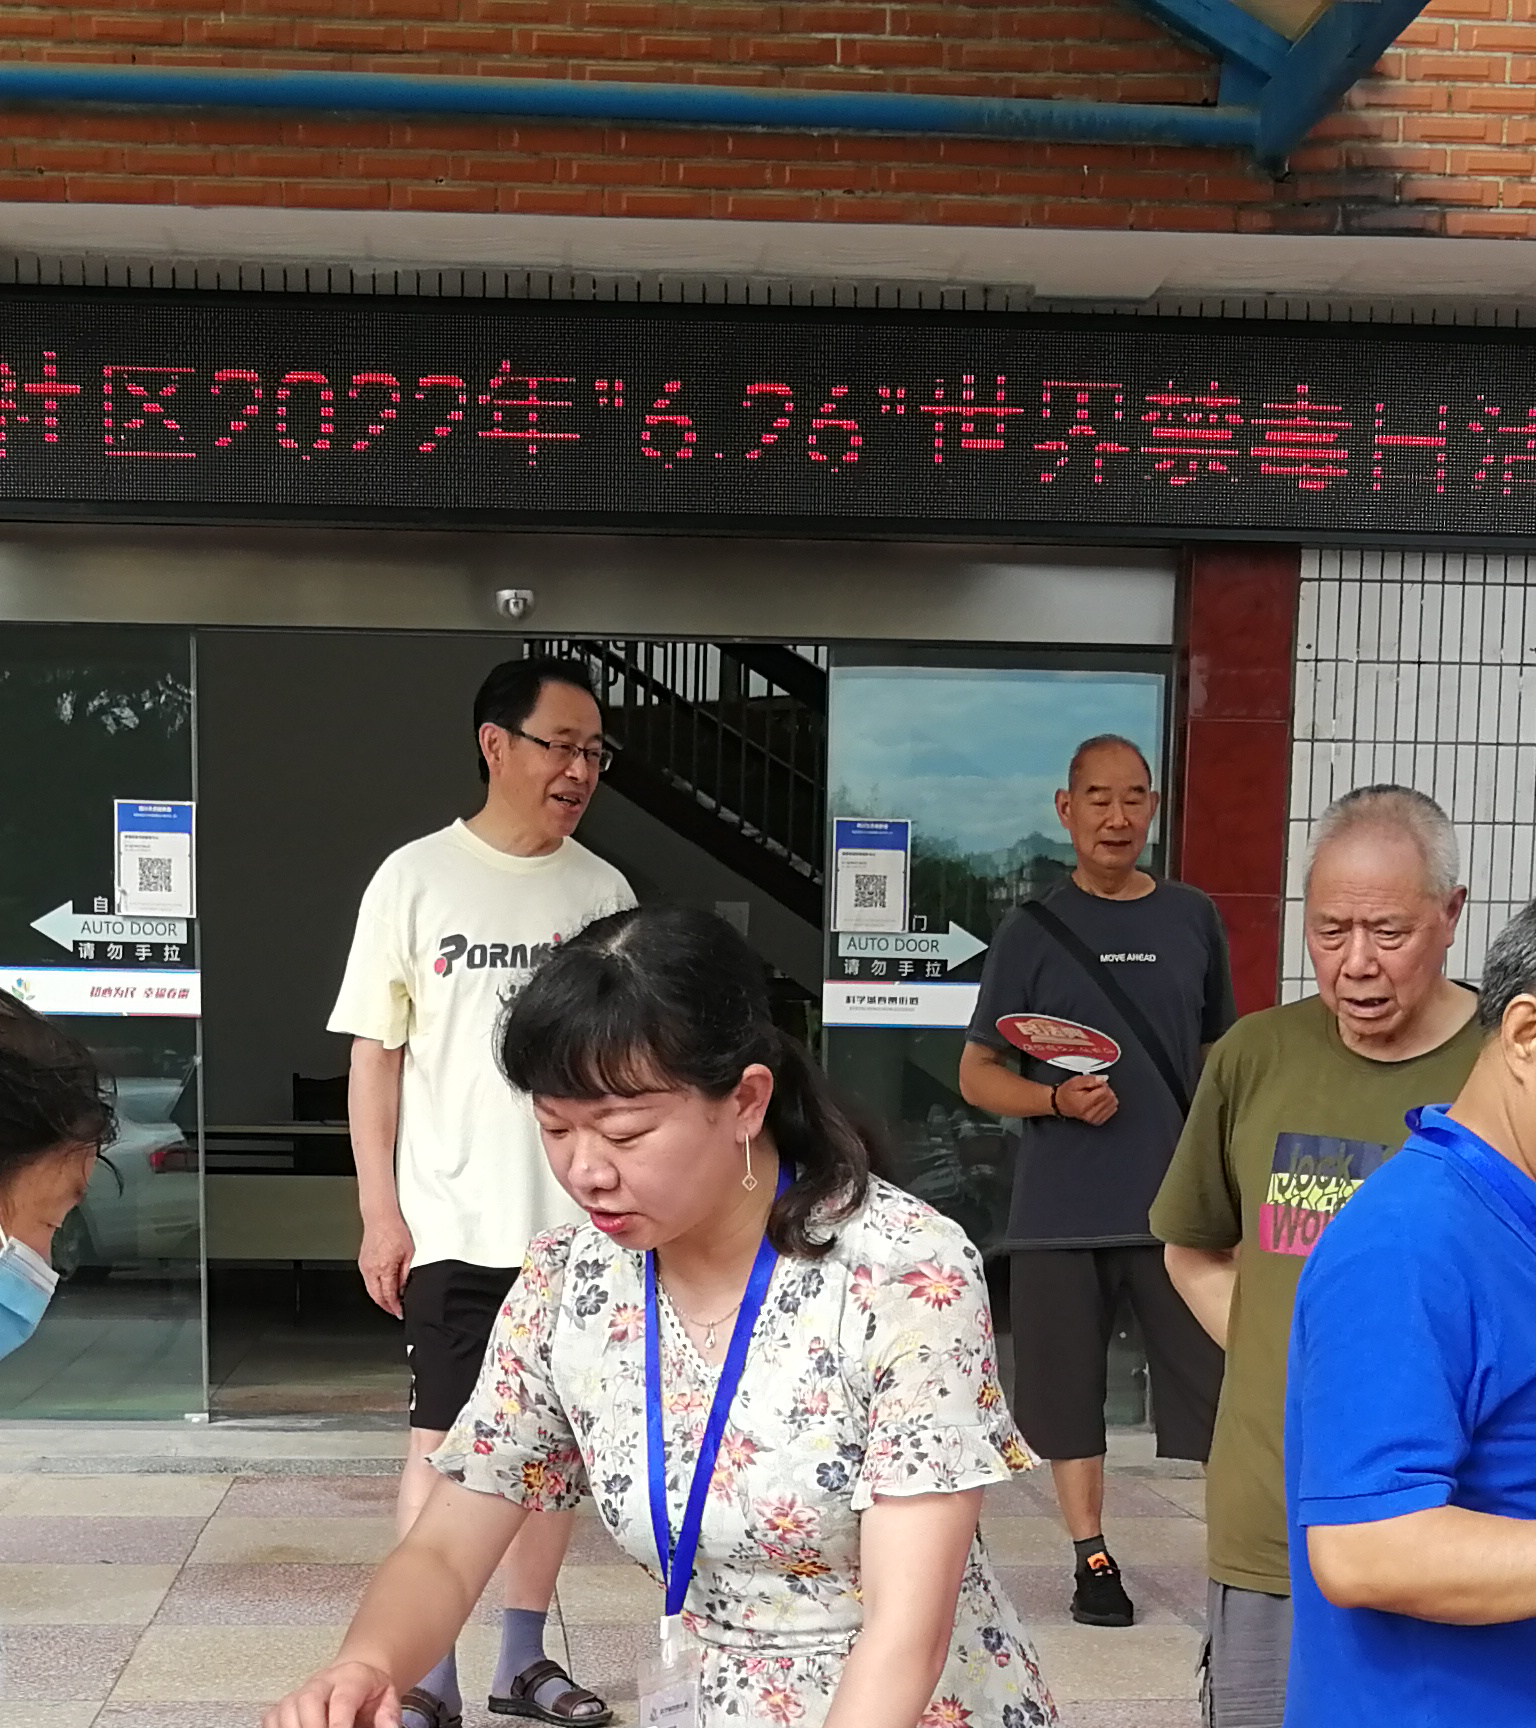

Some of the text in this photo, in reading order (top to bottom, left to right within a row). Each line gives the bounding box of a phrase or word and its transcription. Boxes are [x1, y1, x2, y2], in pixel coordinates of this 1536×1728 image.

[81, 921, 177, 936] AUTO DOOR
[78, 943, 181, 961] 请勿手拉
[847, 937, 939, 953] AUTO DOOR
[1100, 953, 1156, 962] MOVE AHEAD
[844, 959, 941, 978] 请勿手拉
